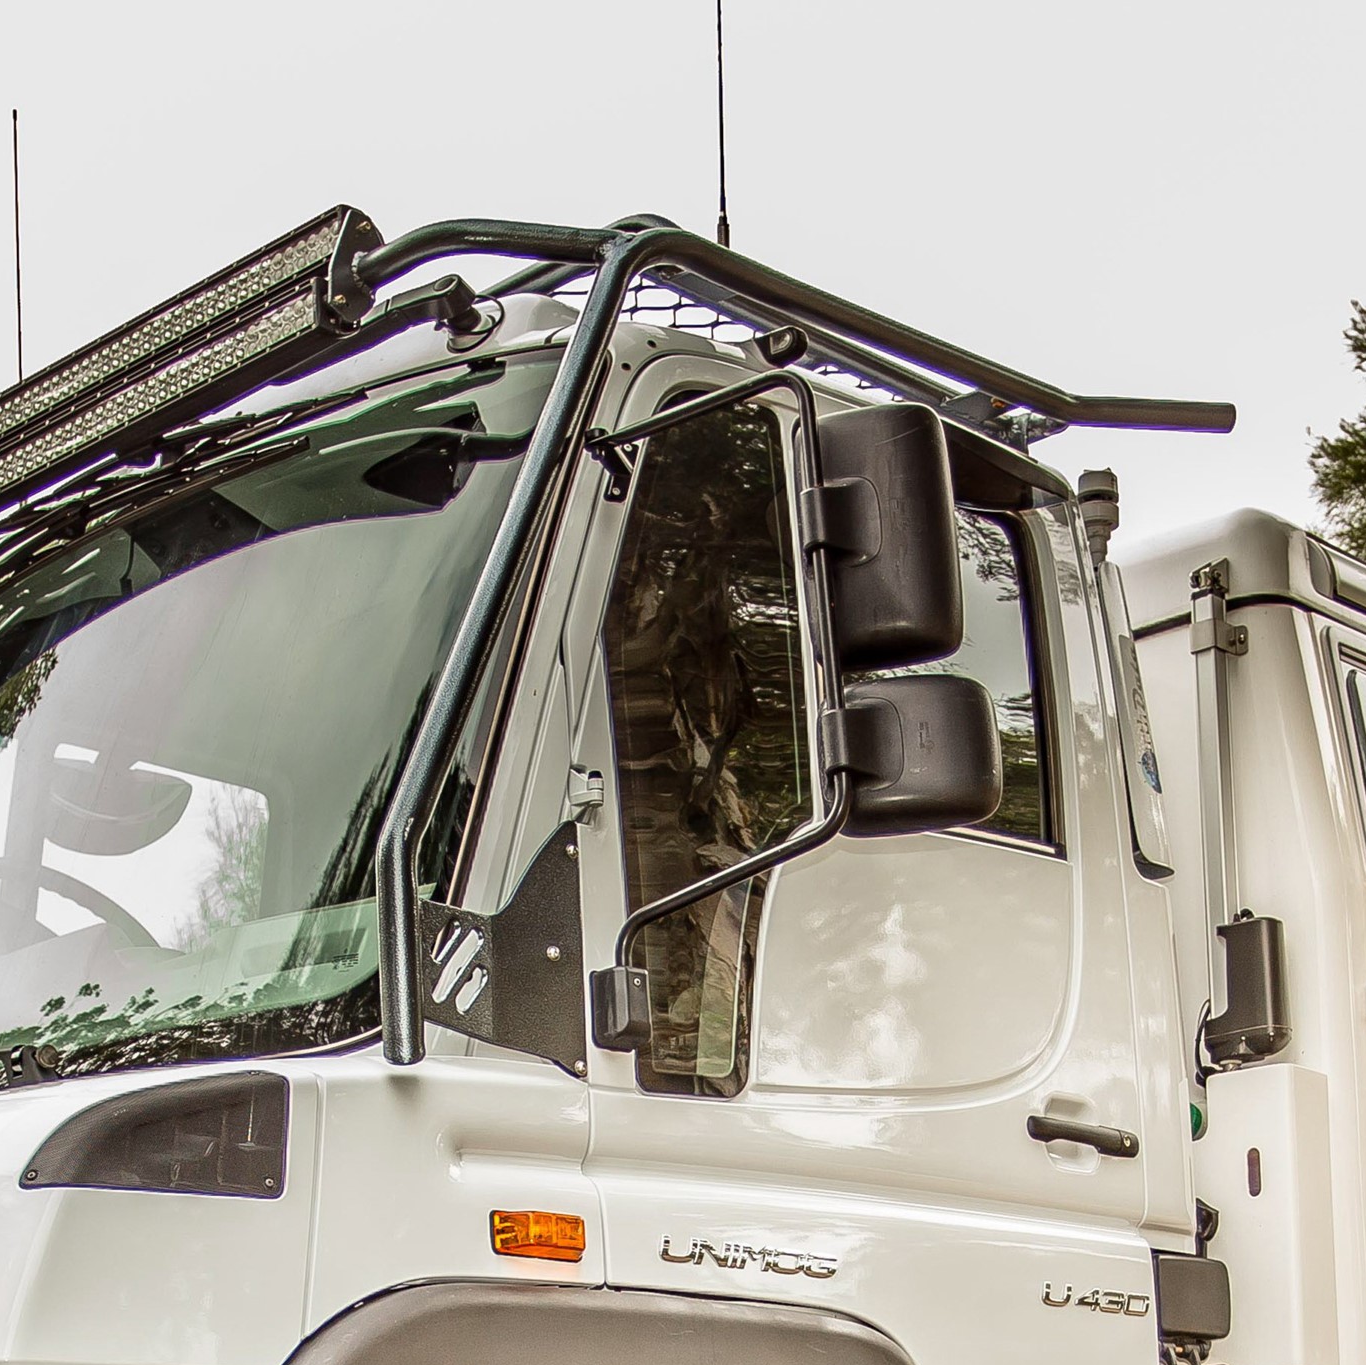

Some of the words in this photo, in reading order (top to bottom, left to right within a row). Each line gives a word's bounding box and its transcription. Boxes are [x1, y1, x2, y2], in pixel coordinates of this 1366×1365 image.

[659, 1234, 838, 1280] UNIMOG
[1041, 1281, 1073, 1307] U
[1074, 1287, 1151, 1317] 430
